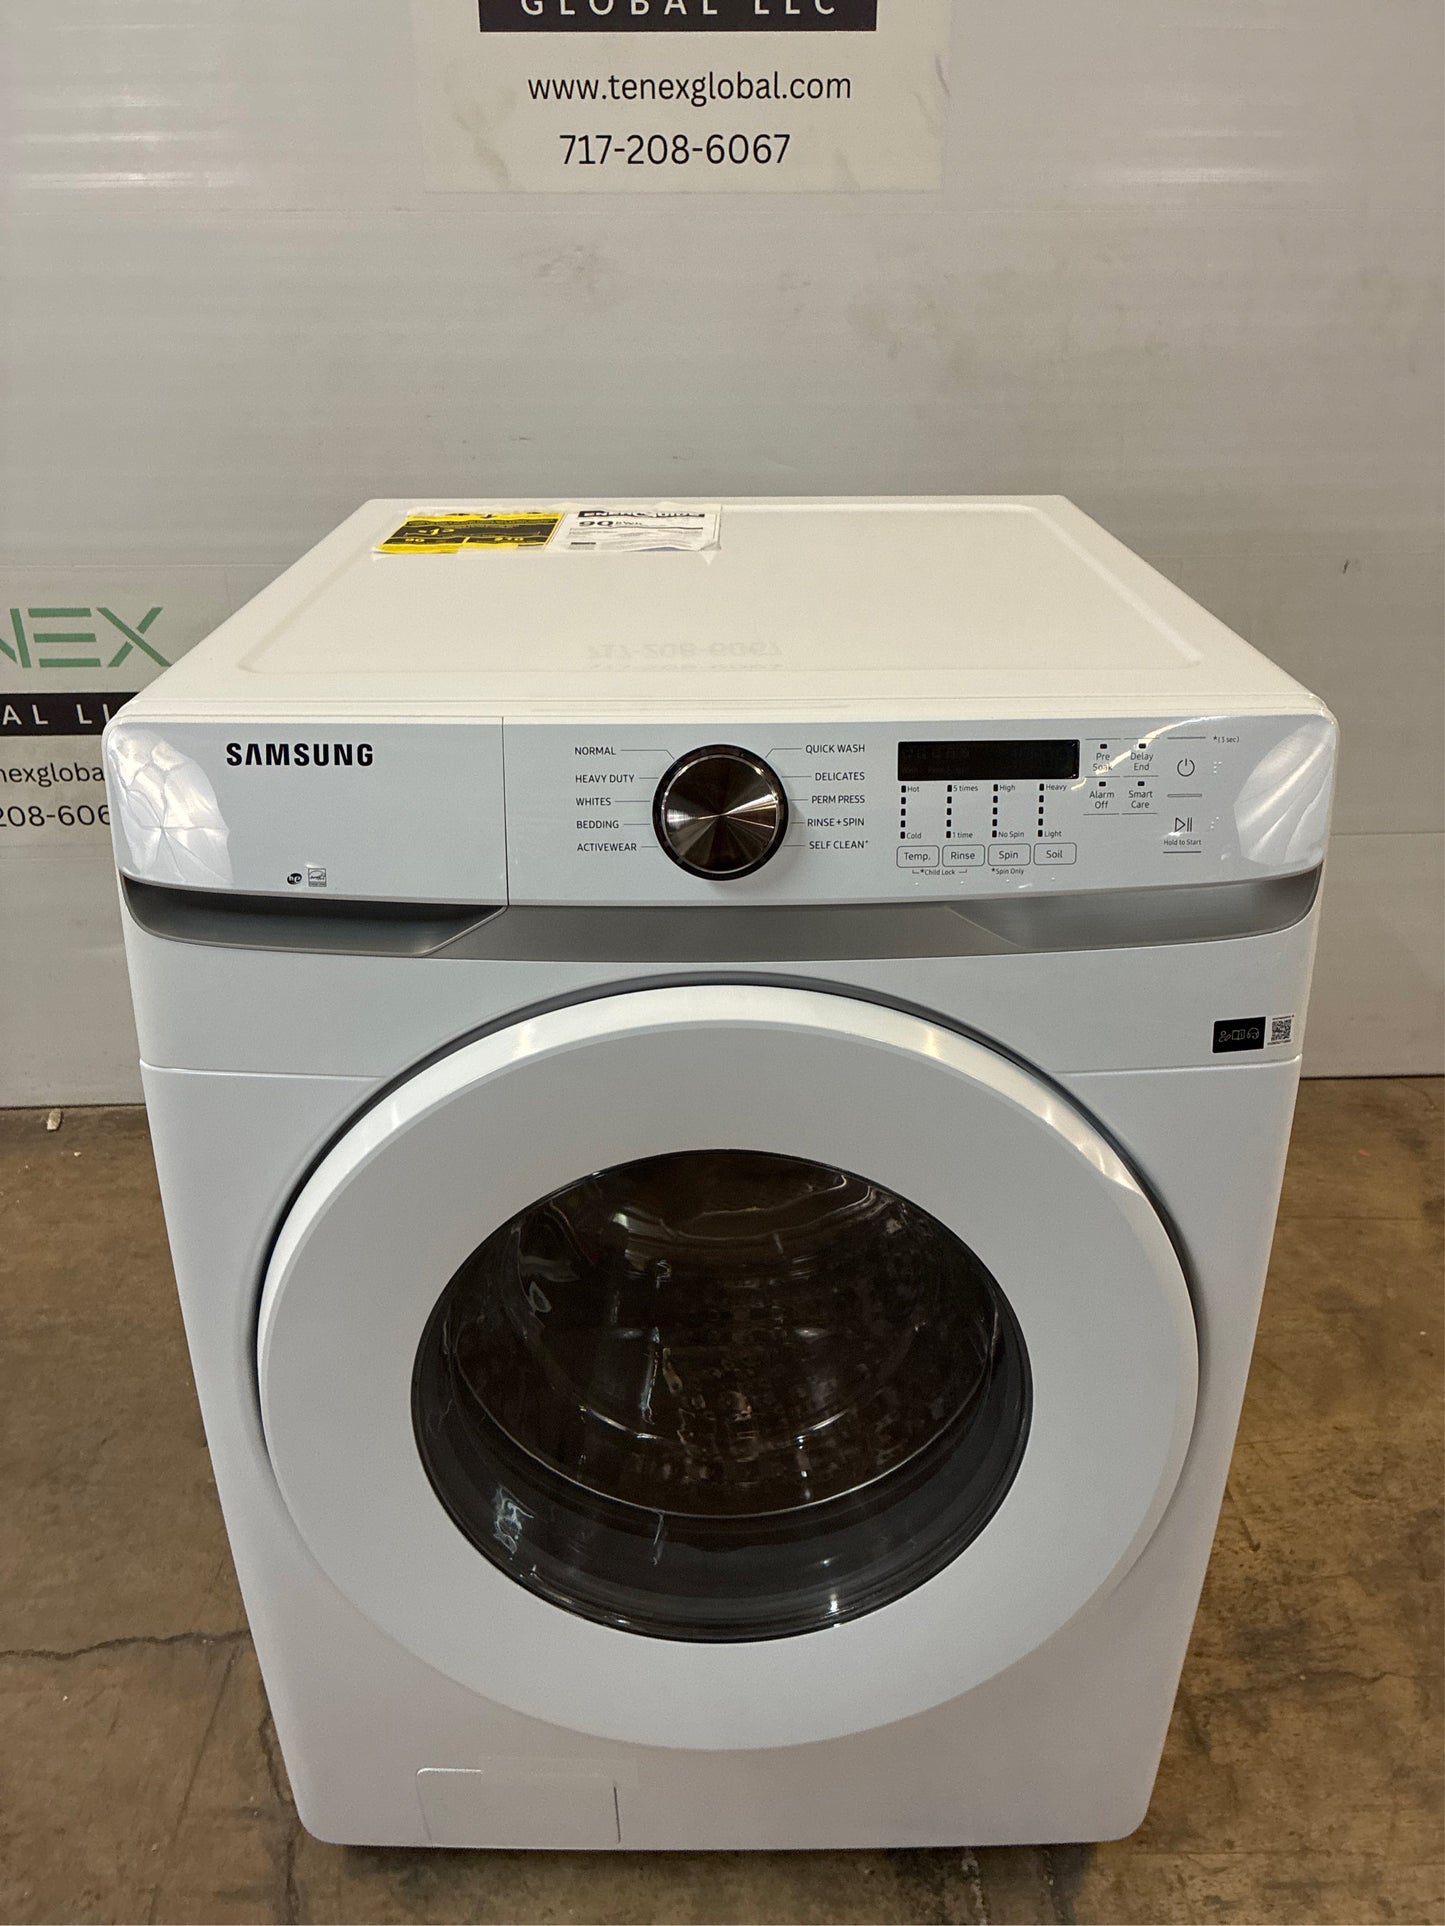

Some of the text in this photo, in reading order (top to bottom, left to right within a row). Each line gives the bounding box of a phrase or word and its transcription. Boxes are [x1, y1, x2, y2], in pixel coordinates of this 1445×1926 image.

[520, 0, 835, 16] GLOBAL LLC
[528, 71, 851, 107] www.tenexglobal.com
[559, 134, 791, 165] 717-208-6067
[574, 746, 617, 756] NORMAL
[805, 743, 865, 755] QUICK WASH
[226, 742, 374, 767] SAMSUNG
[1096, 752, 1110, 761] Pre
[1130, 752, 1154, 762] Delay
[1134, 762, 1150, 771] End
[575, 773, 635, 784] HEAVY DUTY
[815, 771, 866, 781] DELICATES
[907, 785, 920, 793] Hot
[1000, 784, 1016, 793] High
[1046, 784, 1067, 792] Heavy
[1089, 790, 1115, 799] Alarm
[1128, 790, 1153, 798] Smart
[576, 797, 611, 806] WHITES
[811, 795, 866, 804] PERM PRESS
[1094, 800, 1109, 809] Off
[1130, 800, 1150, 809] Care
[576, 820, 620, 830] BEDDING
[906, 832, 922, 840] Cold
[1009, 831, 1025, 839] Spin
[1044, 831, 1062, 839] Light
[577, 842, 637, 852] ACTIVEWEAR
[809, 840, 832, 849] SELF
[904, 852, 931, 862] Temp.
[950, 851, 976, 860] Rinse
[999, 850, 1019, 861] Spin
[1046, 850, 1063, 859] Soil
